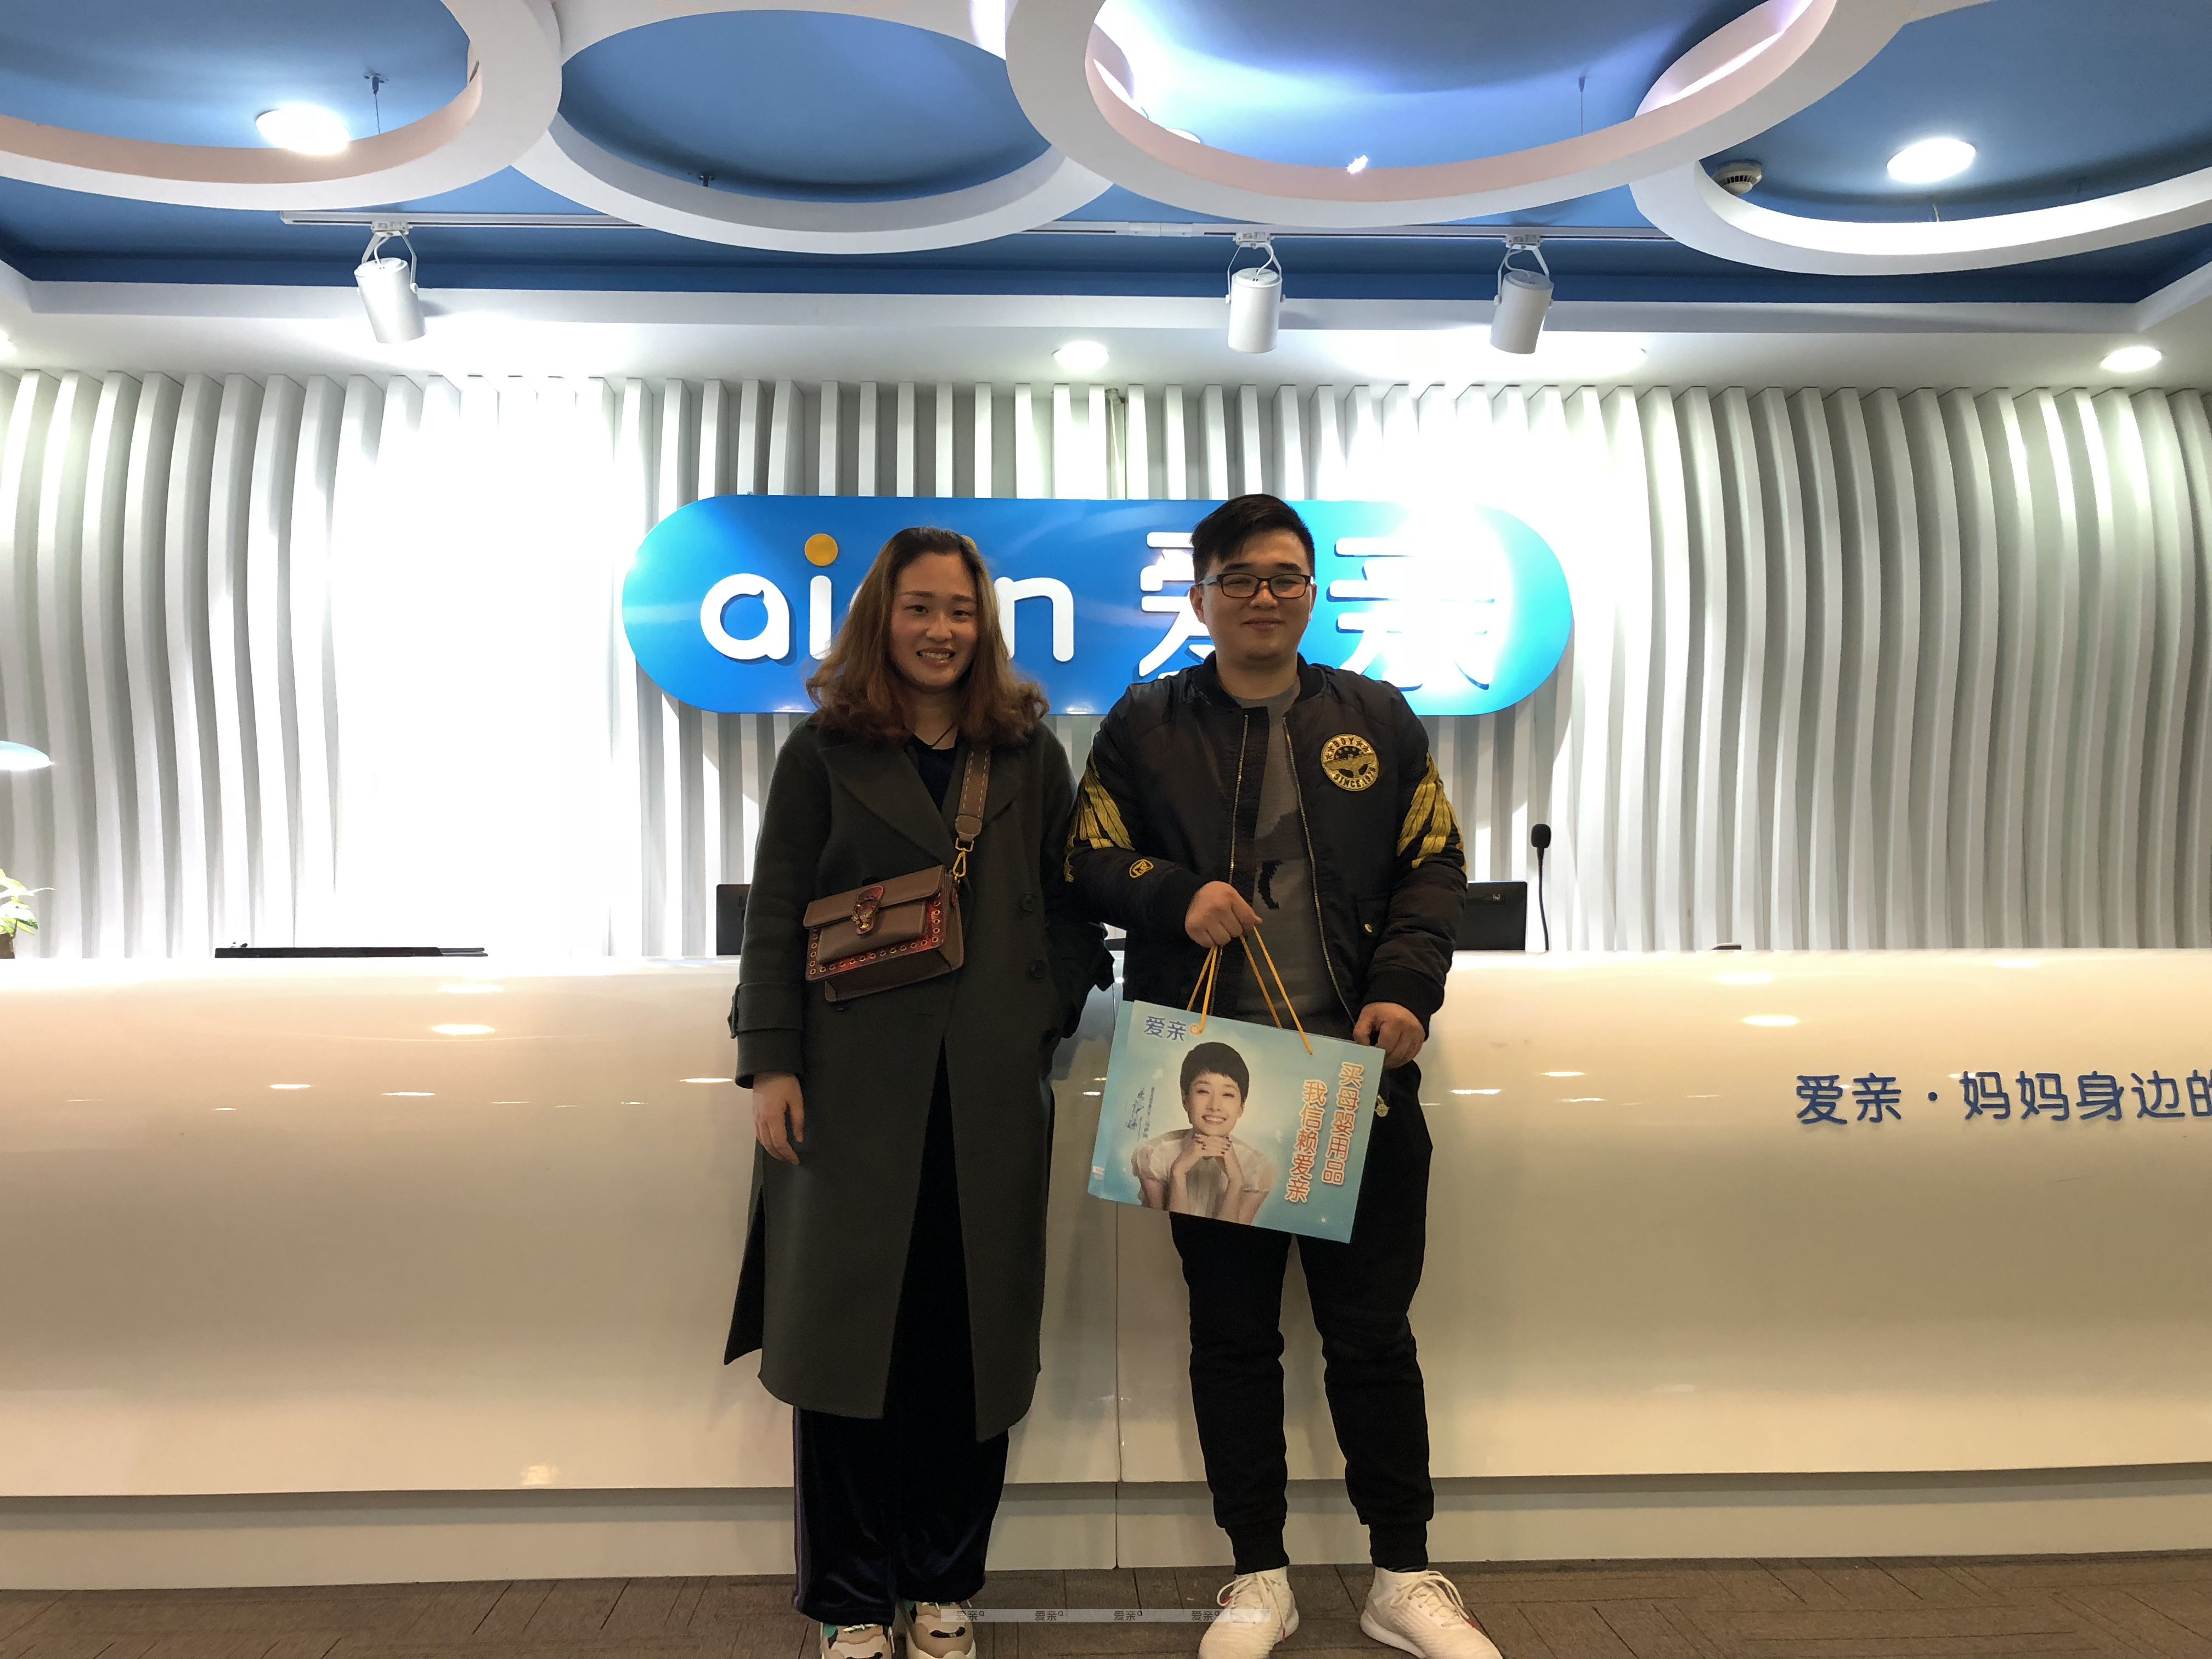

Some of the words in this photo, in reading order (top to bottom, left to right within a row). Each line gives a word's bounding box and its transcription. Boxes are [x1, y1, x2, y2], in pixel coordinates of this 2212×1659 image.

[1333, 737, 1354, 747] BOY
[1144, 1015, 1186, 1041] 爱亲
[1285, 1079, 1328, 1203] 我信赖爱亲
[1322, 1062, 1364, 1186] 买母婴用品
